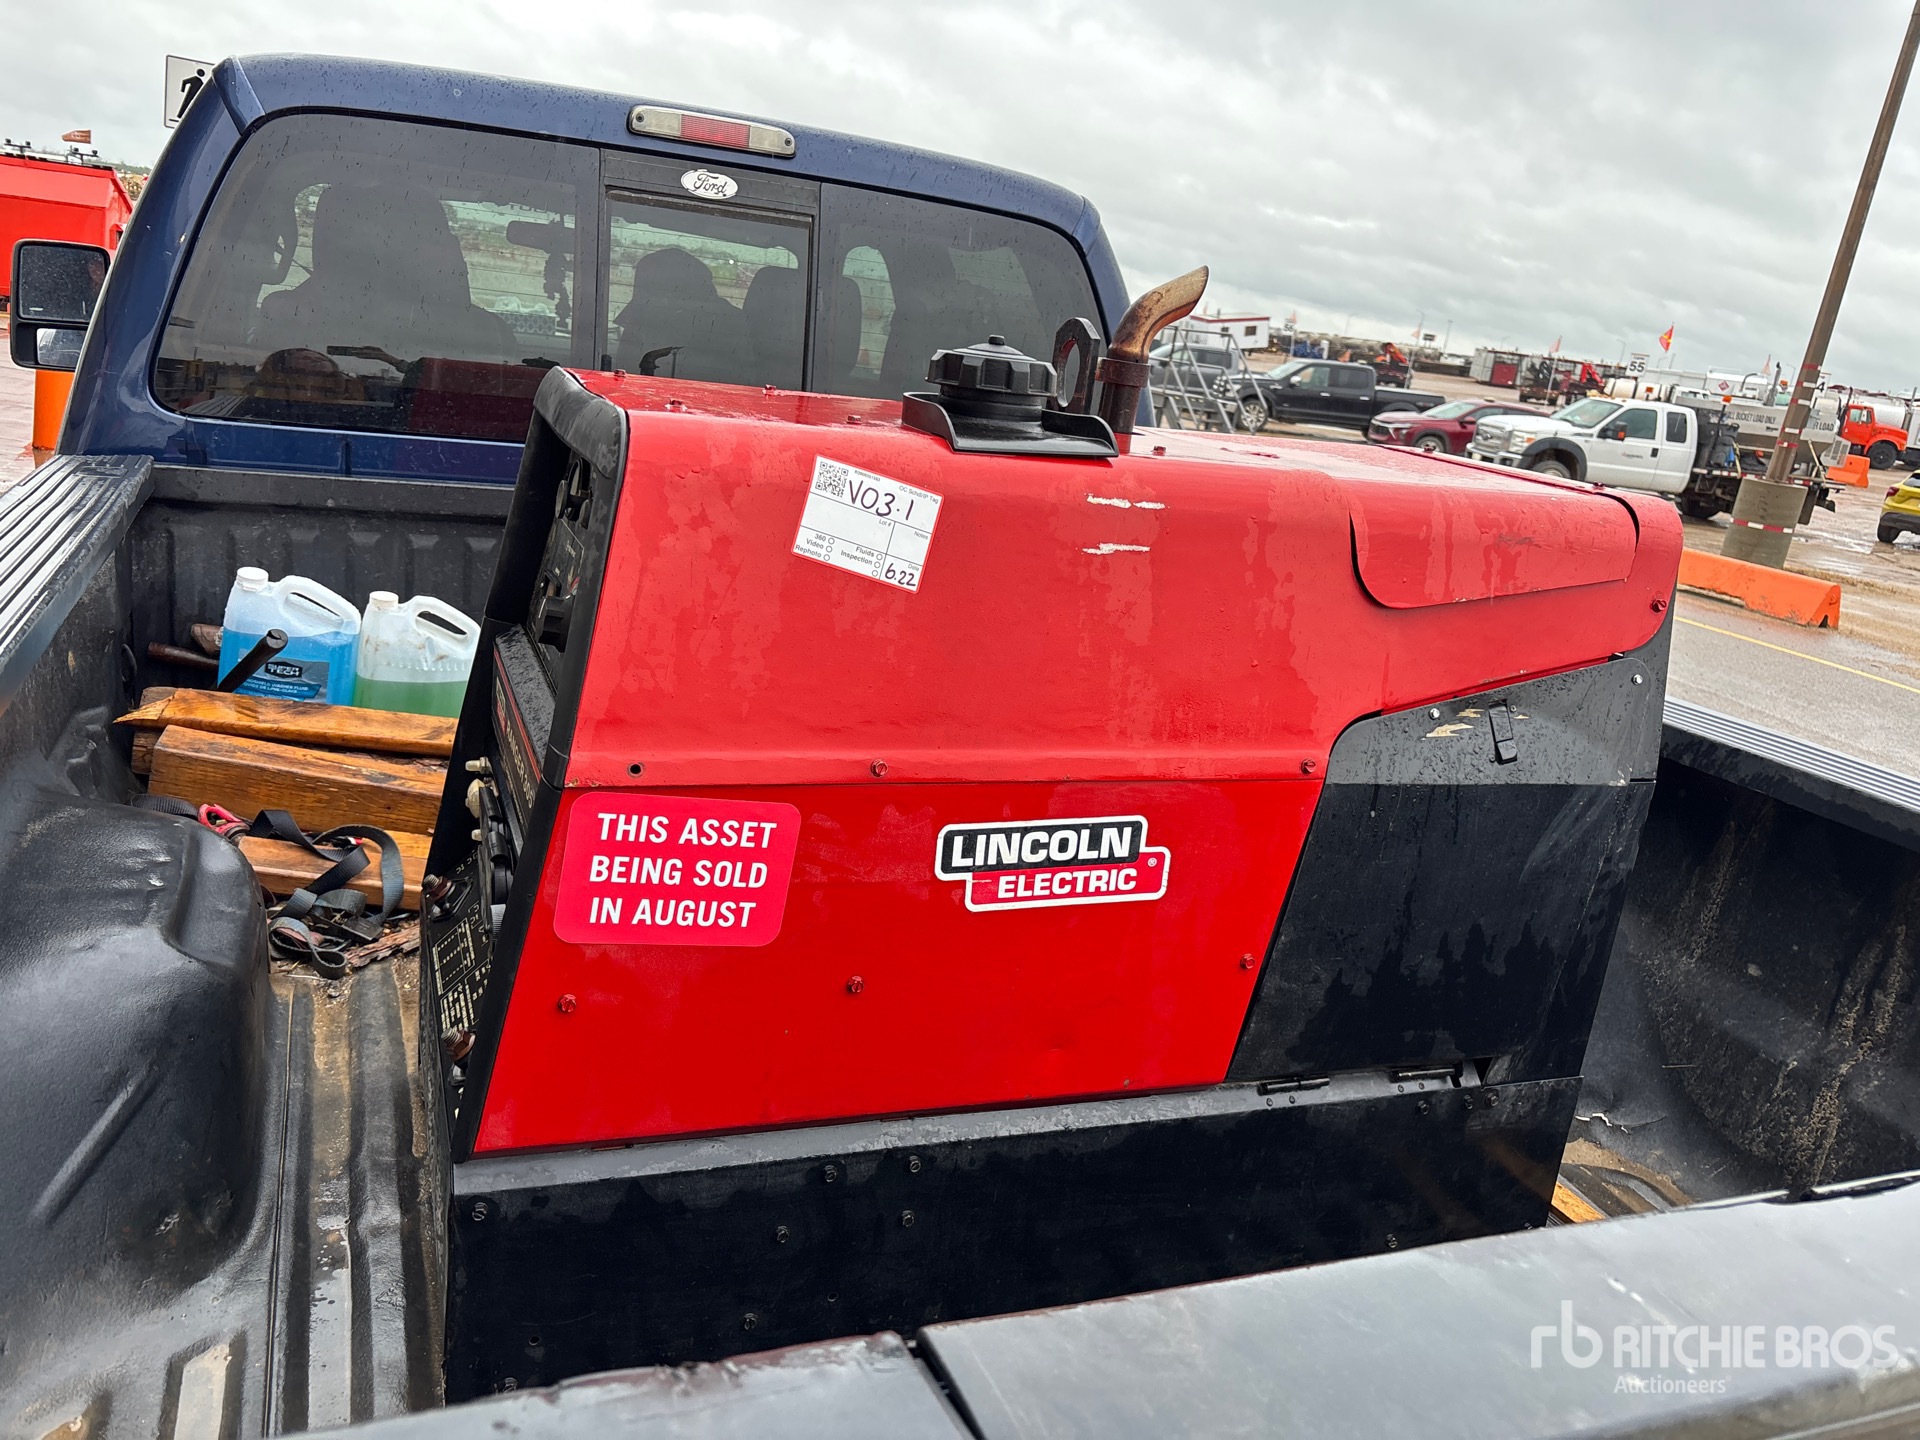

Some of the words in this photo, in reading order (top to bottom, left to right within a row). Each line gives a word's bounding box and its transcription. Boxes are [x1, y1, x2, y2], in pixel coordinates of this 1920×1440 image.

[694, 173, 728, 194] Ford
[1629, 361, 1646, 372] 55
[1736, 411, 1753, 421] BUCKET
[1753, 414, 1765, 423] LOAD
[1765, 415, 1777, 424] ONLY
[1820, 421, 1835, 431] LOAD
[929, 496, 939, 504] Tag
[814, 533, 827, 542] 360
[913, 531, 929, 540] Notes
[806, 538, 824, 549] Video
[795, 544, 822, 558] Rephoto
[855, 546, 875, 558] Fluids
[840, 550, 873, 566] Inspection
[907, 563, 920, 571] Date
[884, 563, 916, 587] 6.22
[269, 668, 300, 676] TECH
[506, 719, 525, 782] RANGER
[598, 813, 669, 844] THIS
[678, 818, 777, 848] ASSET
[951, 826, 1133, 867] LINCOLN
[589, 855, 683, 885] BEING
[693, 860, 768, 888] SOLD
[997, 868, 1138, 899] ELECTRIC
[589, 897, 623, 924] IN
[631, 899, 756, 927] AUGUST
